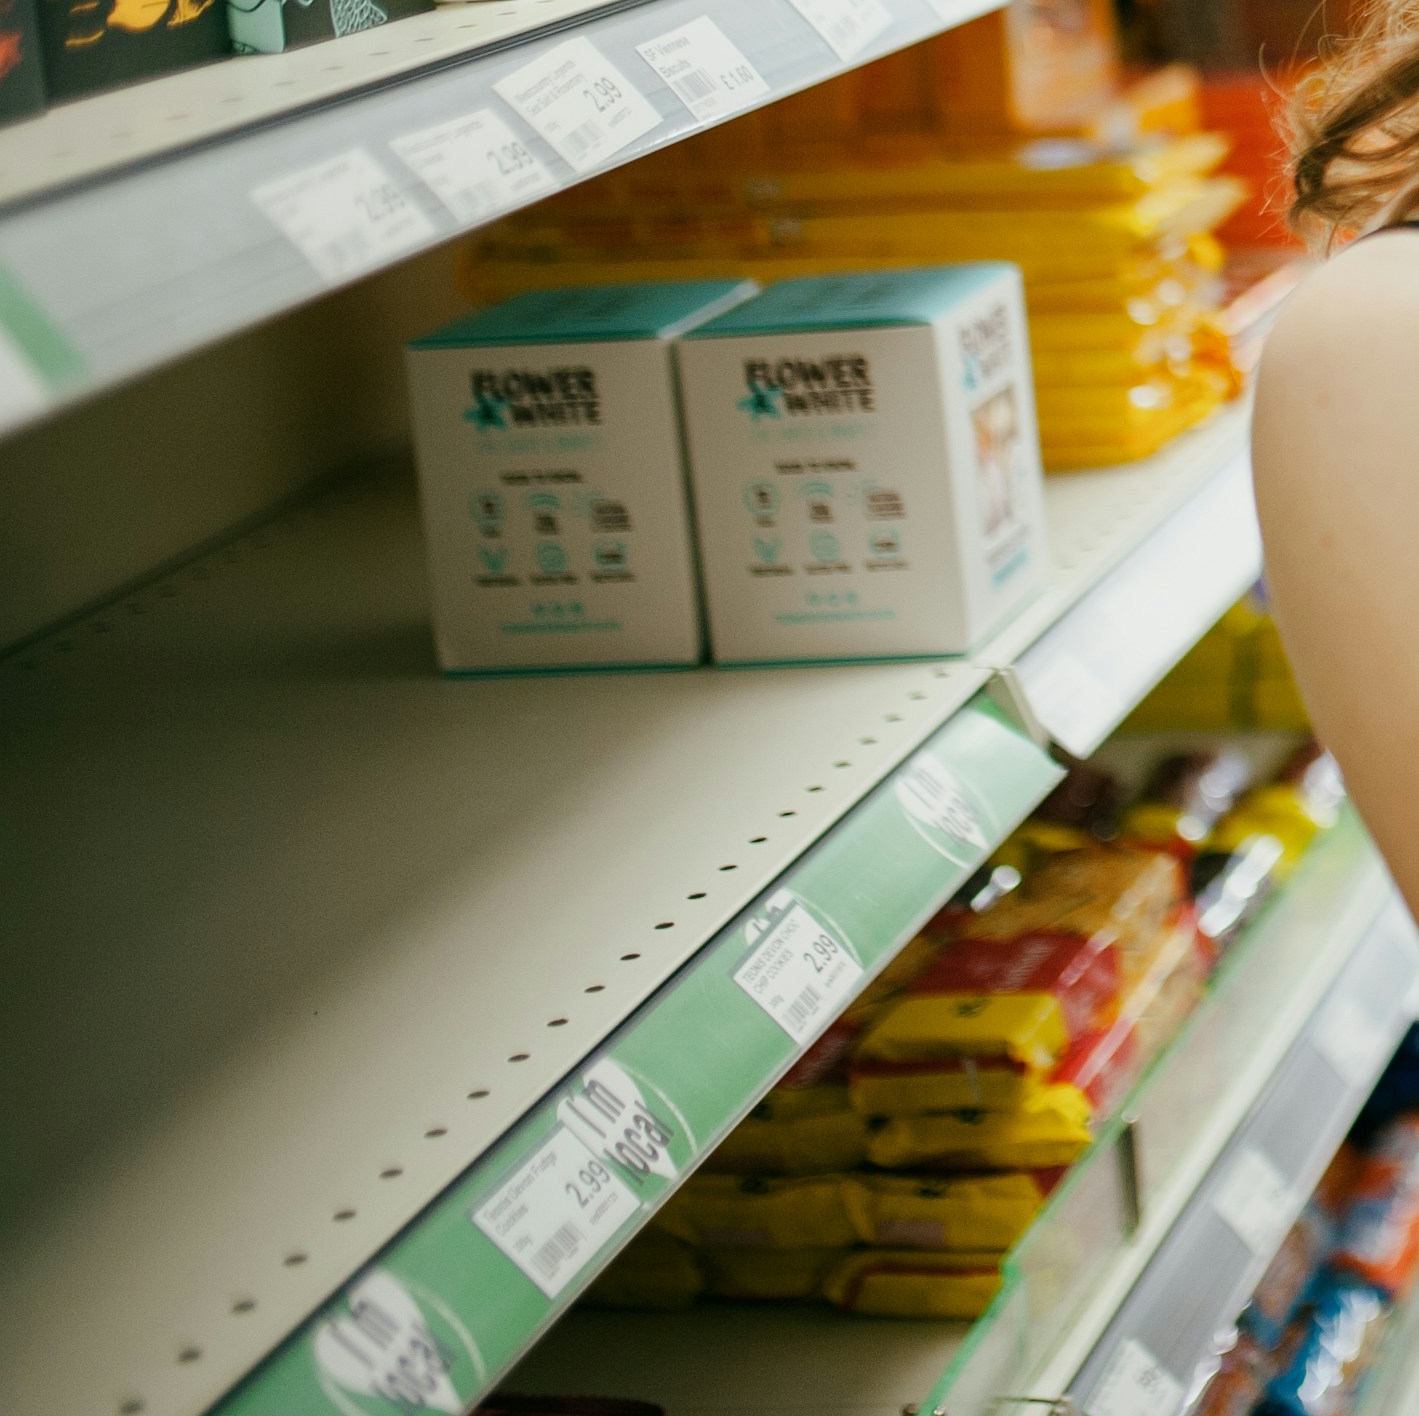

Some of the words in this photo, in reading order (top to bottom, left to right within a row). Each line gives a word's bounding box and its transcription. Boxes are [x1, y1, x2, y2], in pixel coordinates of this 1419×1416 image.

[653, 33, 692, 57] Viennese
[657, 56, 692, 78] Biscuits
[717, 73, 735, 90] £
[578, 75, 626, 112] 2.99
[487, 142, 534, 176] 2.99
[471, 366, 597, 401] FLOWER
[744, 353, 870, 392] FLOWER
[511, 401, 601, 427] WHITE
[784, 388, 875, 416] WHITE
[742, 956, 767, 985] TEONIS
[760, 935, 785, 963] DEVON
[765, 947, 795, 980] COOKIES
[800, 930, 841, 975] 2.99
[567, 1078, 626, 1139] I'm
[603, 1100, 675, 1186] local
[560, 1157, 613, 1210] 2.99
